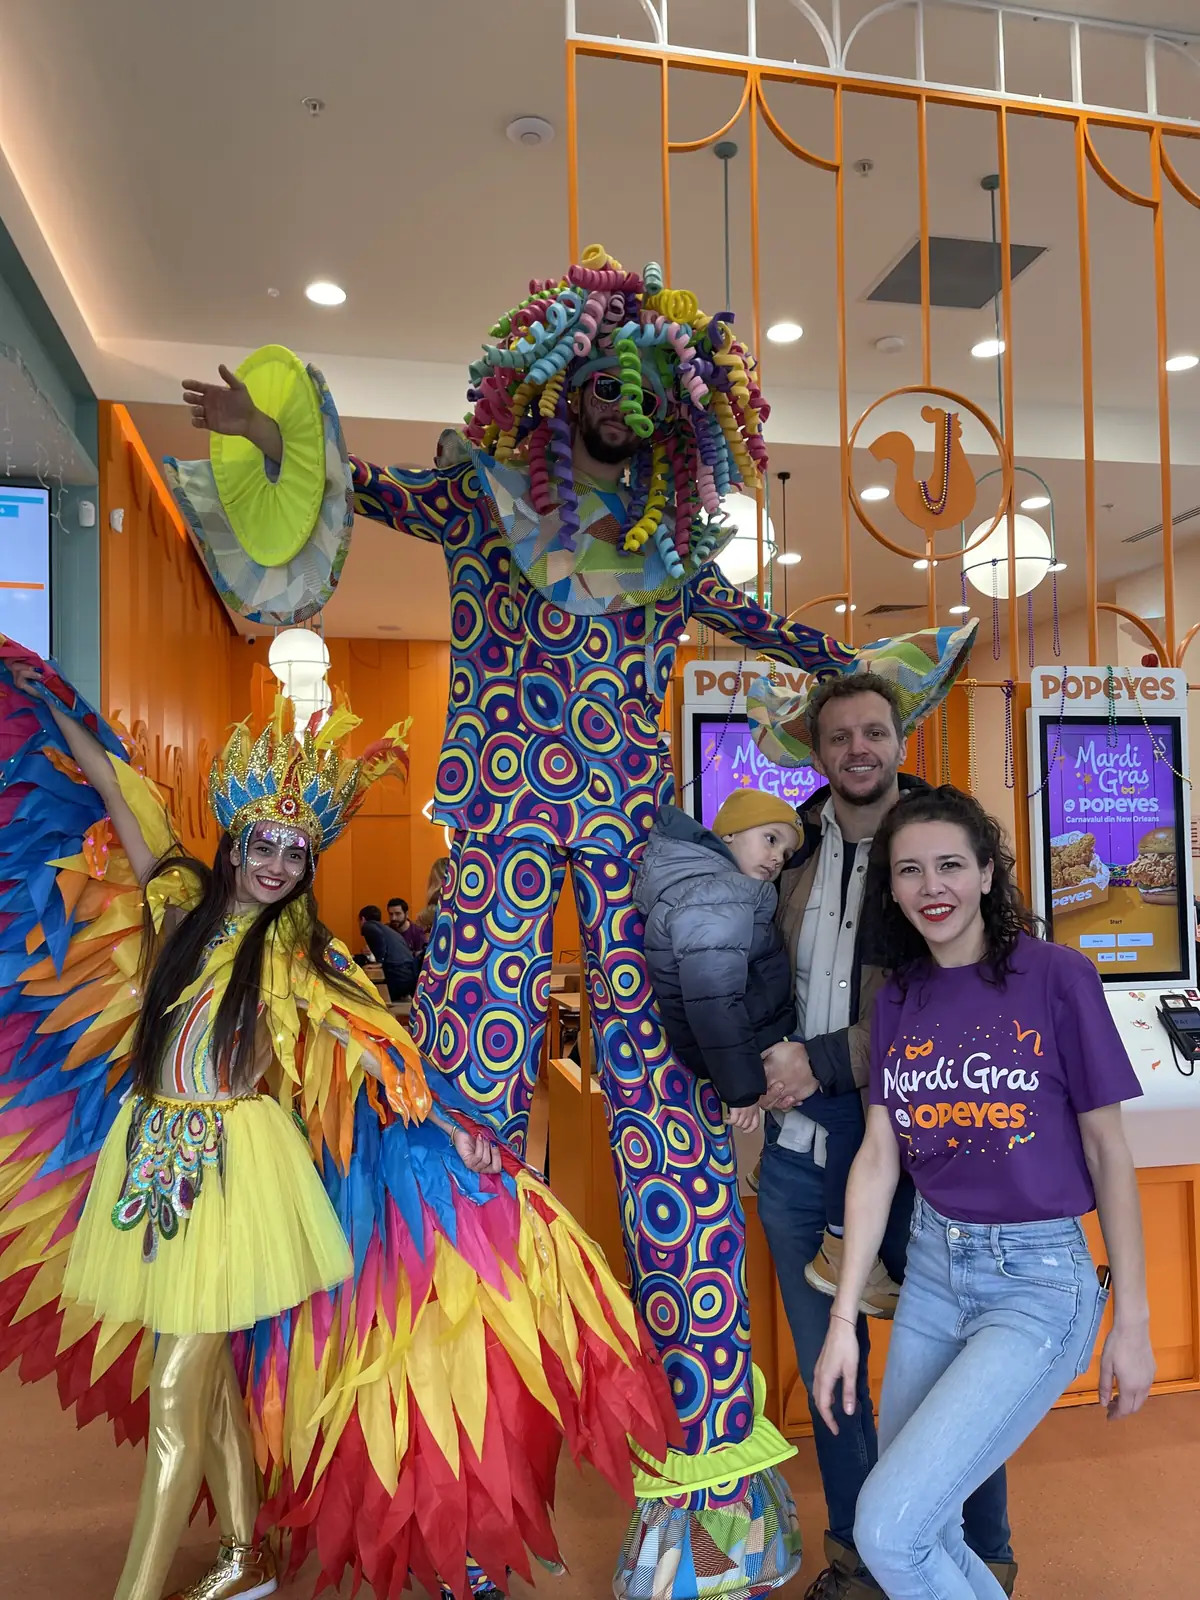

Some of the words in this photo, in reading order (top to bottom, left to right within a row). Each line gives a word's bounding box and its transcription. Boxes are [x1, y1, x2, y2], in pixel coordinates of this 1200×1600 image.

[1074, 740, 1142, 775] Mardi
[759, 768, 815, 798] Gras
[1099, 768, 1149, 796] Gras
[1065, 815, 1103, 824] Carnavalul
[1104, 815, 1115, 823] din
[1116, 815, 1132, 823] New
[1133, 815, 1160, 823] Orleans
[883, 1056, 959, 1103] Mardi
[962, 1052, 1040, 1095] Gras
